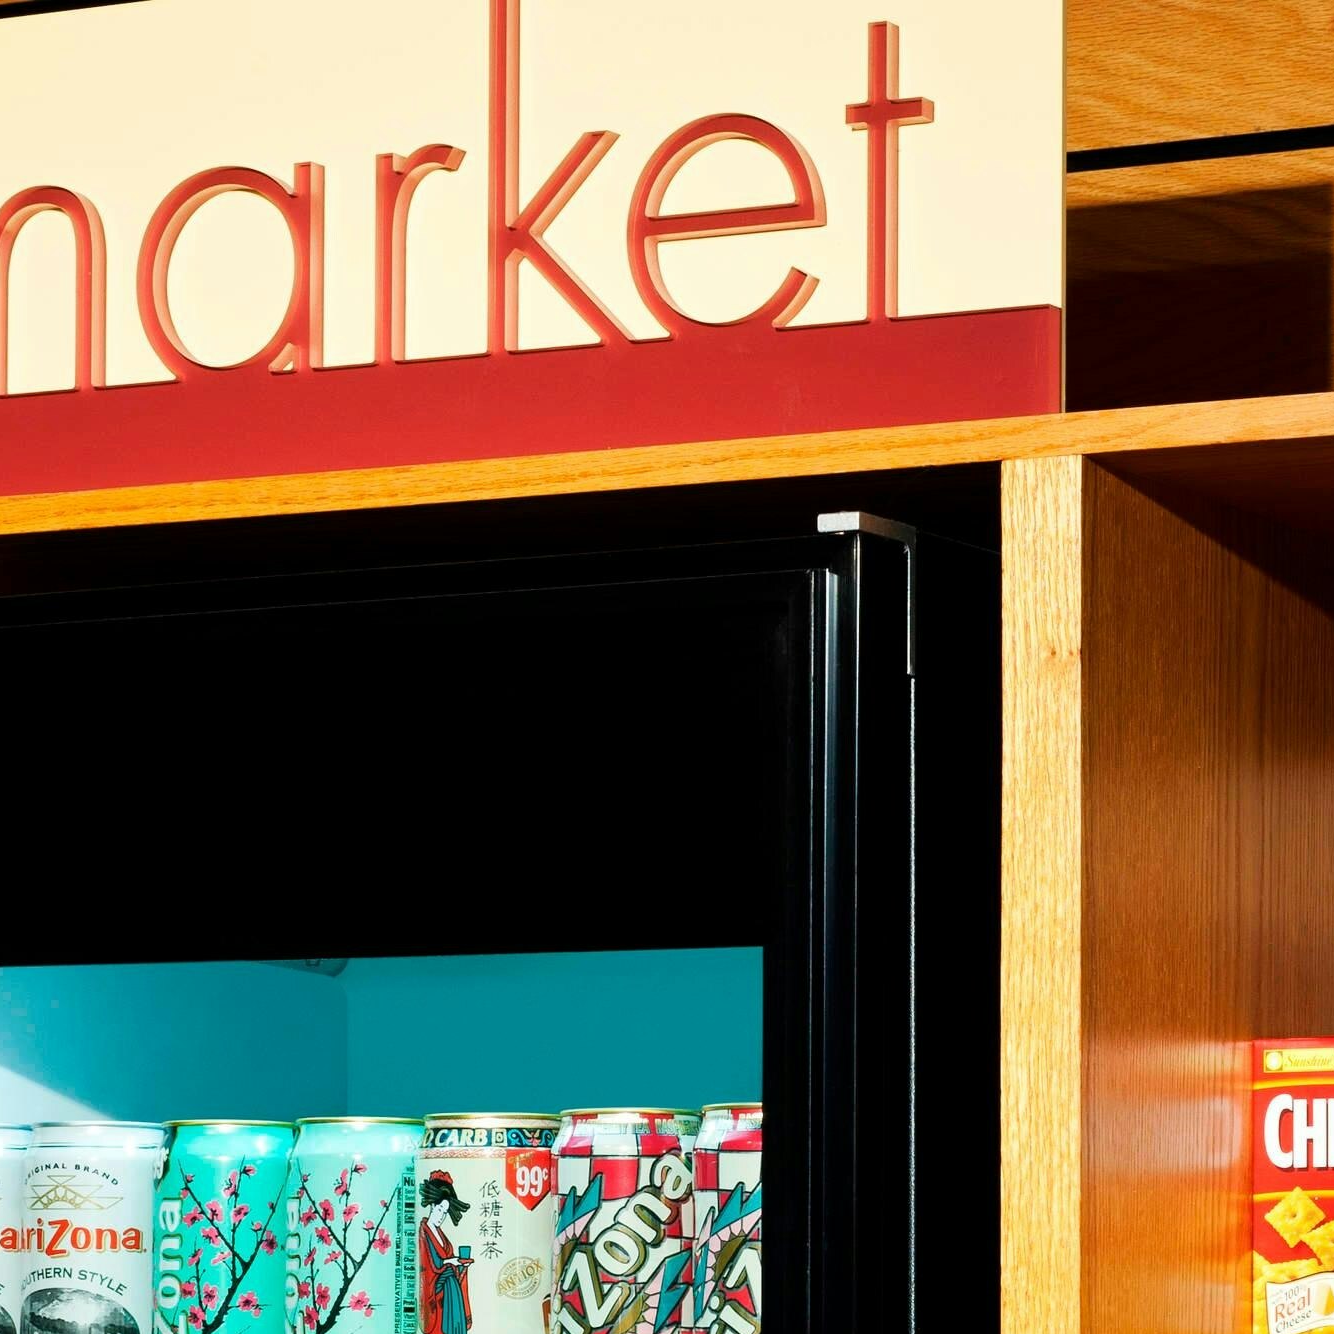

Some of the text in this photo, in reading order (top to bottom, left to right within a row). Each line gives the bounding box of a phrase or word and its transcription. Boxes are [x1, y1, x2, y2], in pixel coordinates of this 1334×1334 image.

[435, 1129, 488, 1146] CARB
[75, 1164, 119, 1186] BRAND
[516, 1165, 548, 1196] 99¢
